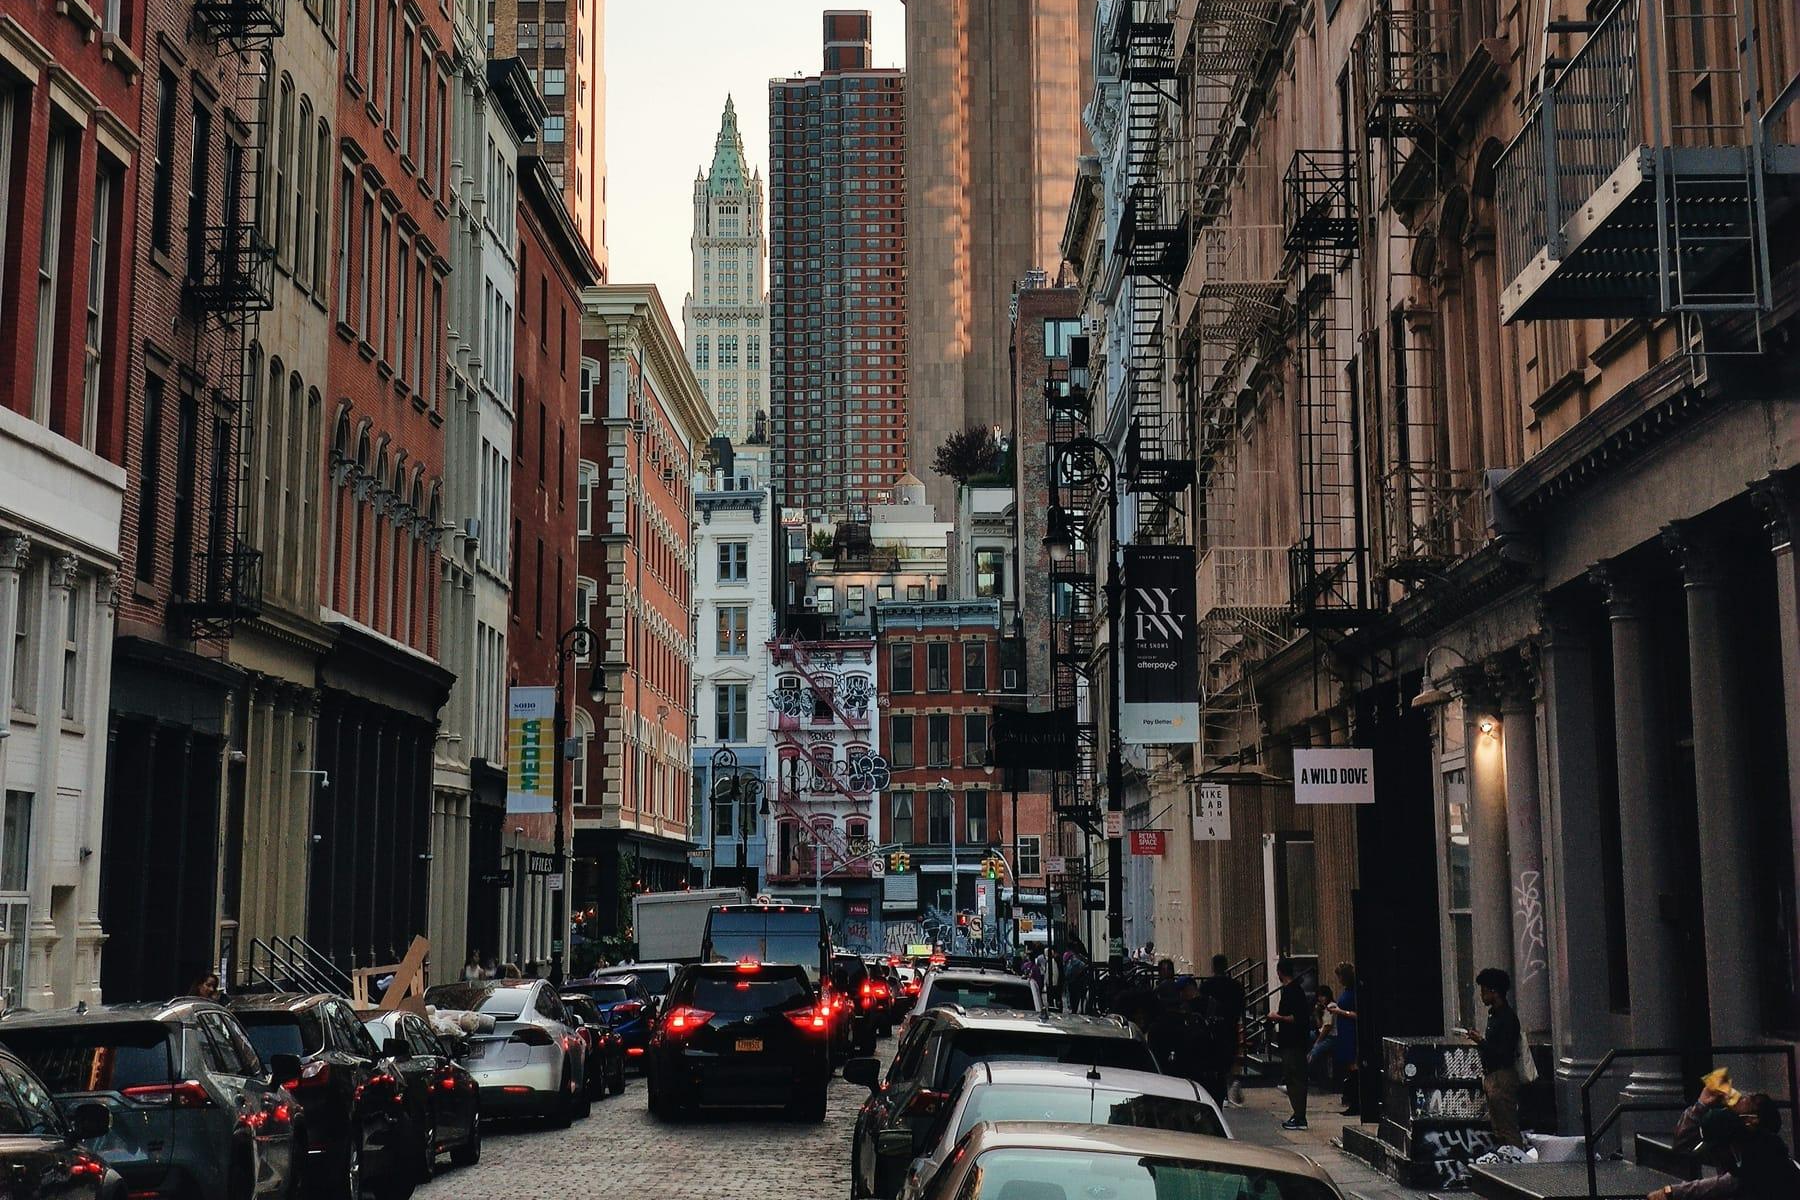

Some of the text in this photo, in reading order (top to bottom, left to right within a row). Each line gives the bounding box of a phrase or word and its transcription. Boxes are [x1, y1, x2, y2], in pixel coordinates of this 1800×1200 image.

[1134, 587, 1178, 613] NY
[1135, 614, 1186, 640] FW
[1137, 661, 1169, 671] afterpay
[520, 720, 540, 791] MEDIA
[1301, 768, 1368, 784] A WILD DOVE
[531, 856, 553, 872] VFILES
